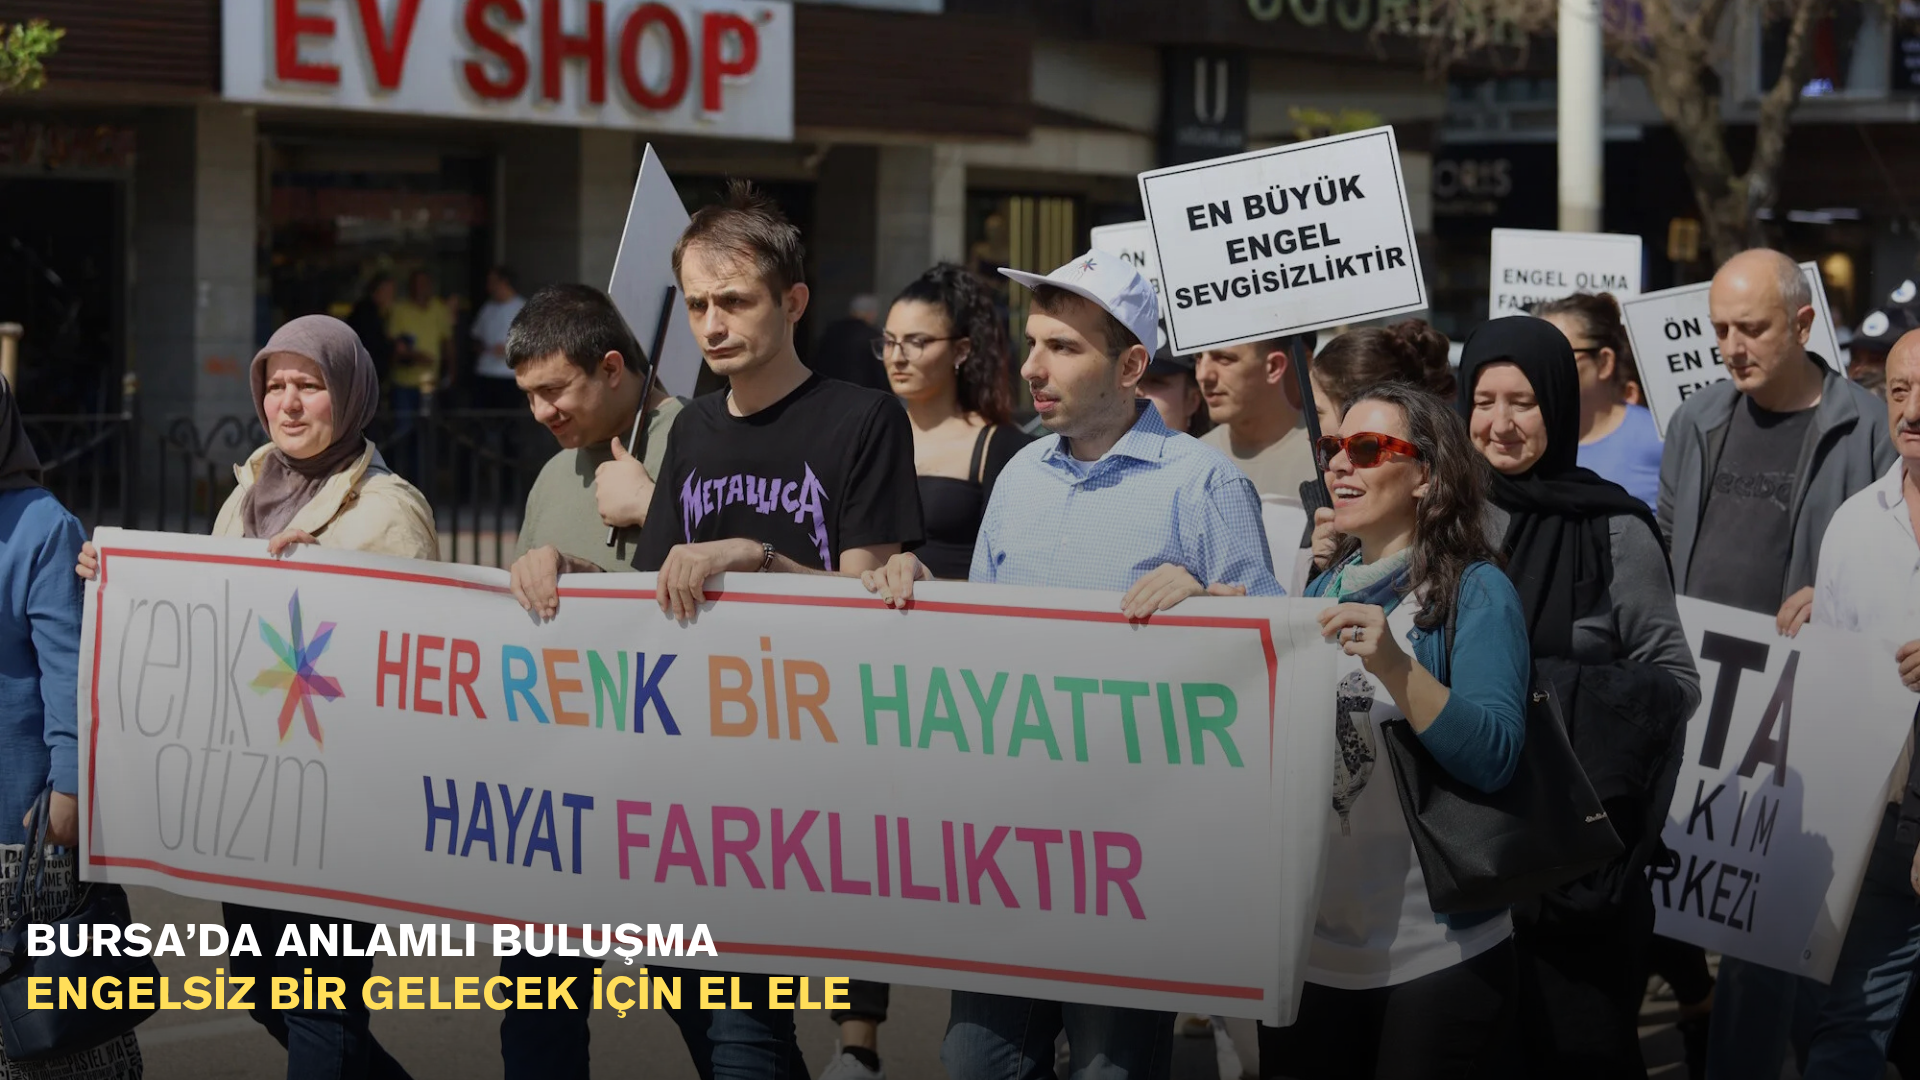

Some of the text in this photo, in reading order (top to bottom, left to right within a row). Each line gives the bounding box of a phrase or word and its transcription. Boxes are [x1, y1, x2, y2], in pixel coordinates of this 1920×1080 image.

[275, 0, 760, 112] EV SHOP
[1186, 174, 1365, 231] EN BÜYÜK
[1174, 245, 1407, 310] SEVGİSİZLİKTİR
[1226, 222, 1341, 265] ENGEL
[1503, 269, 1629, 290] ENGEL OLMA
[1664, 317, 1702, 341] ÖN
[1667, 350, 1702, 373] EN
[680, 461, 832, 571] METALLICA
[116, 580, 253, 747] renk
[375, 630, 1245, 768] HER RENK BİR HAYATTIR
[155, 730, 329, 870] otizm
[1686, 779, 1780, 857] KIM
[422, 775, 1147, 920] HAYAT FARKLILIKTIR
